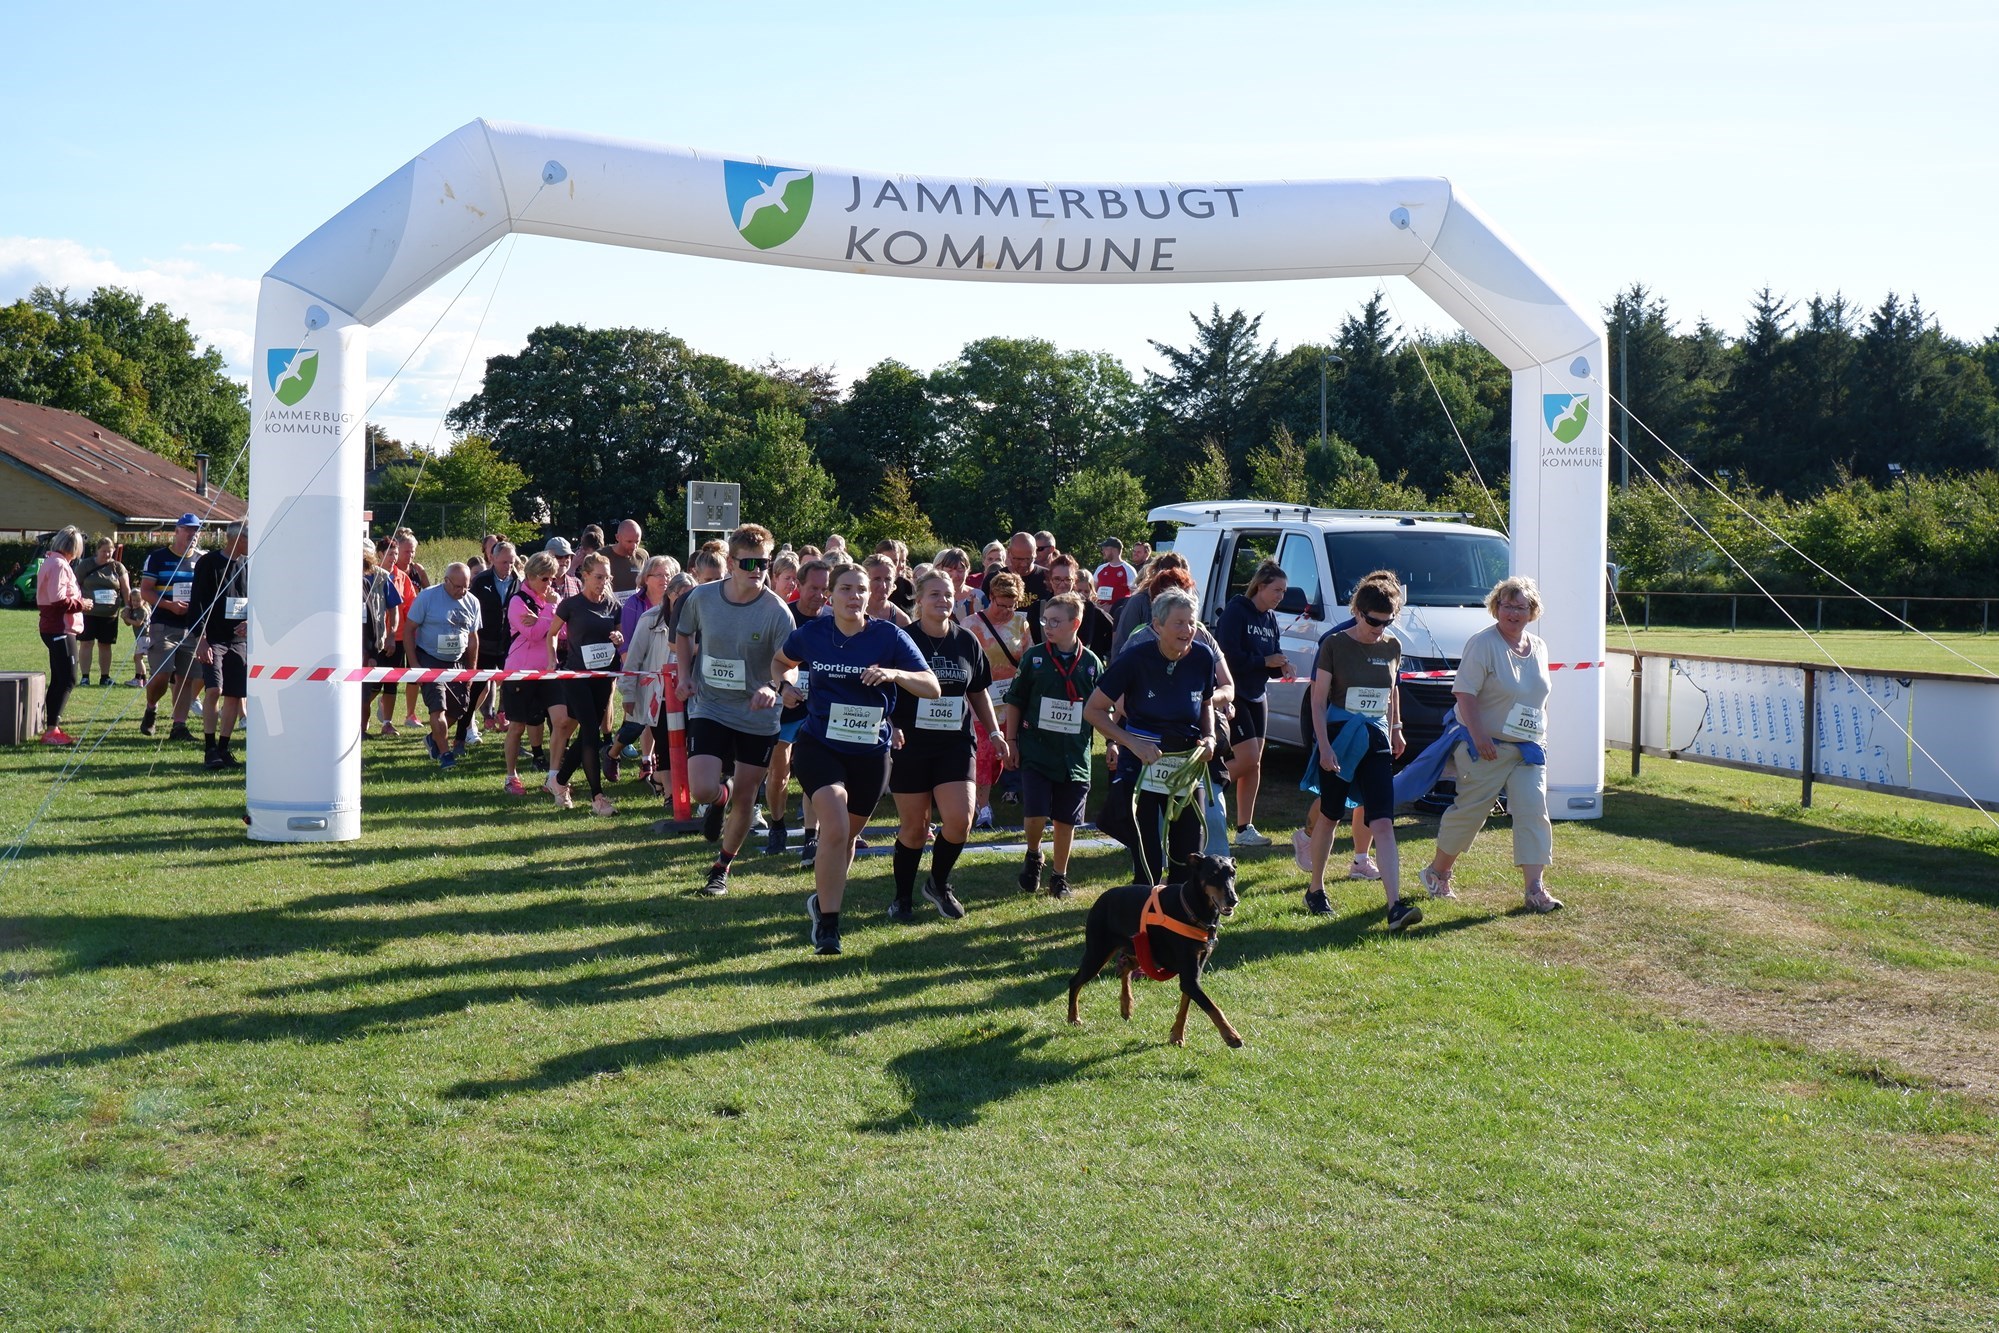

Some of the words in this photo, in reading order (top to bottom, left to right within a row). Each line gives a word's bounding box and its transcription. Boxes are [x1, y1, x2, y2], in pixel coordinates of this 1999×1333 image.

[844, 176, 1244, 219] JAMMERBUGT
[845, 226, 1177, 272] KOMMUNE
[265, 410, 355, 423] JAMMERBUGT
[265, 423, 341, 436] KOMMUNE
[592, 651, 608, 660] 1001
[712, 668, 734, 678] 1076
[1360, 699, 1377, 709] 977
[929, 708, 953, 718] 1046
[1050, 711, 1073, 722] 1071
[842, 718, 868, 729] 1044
